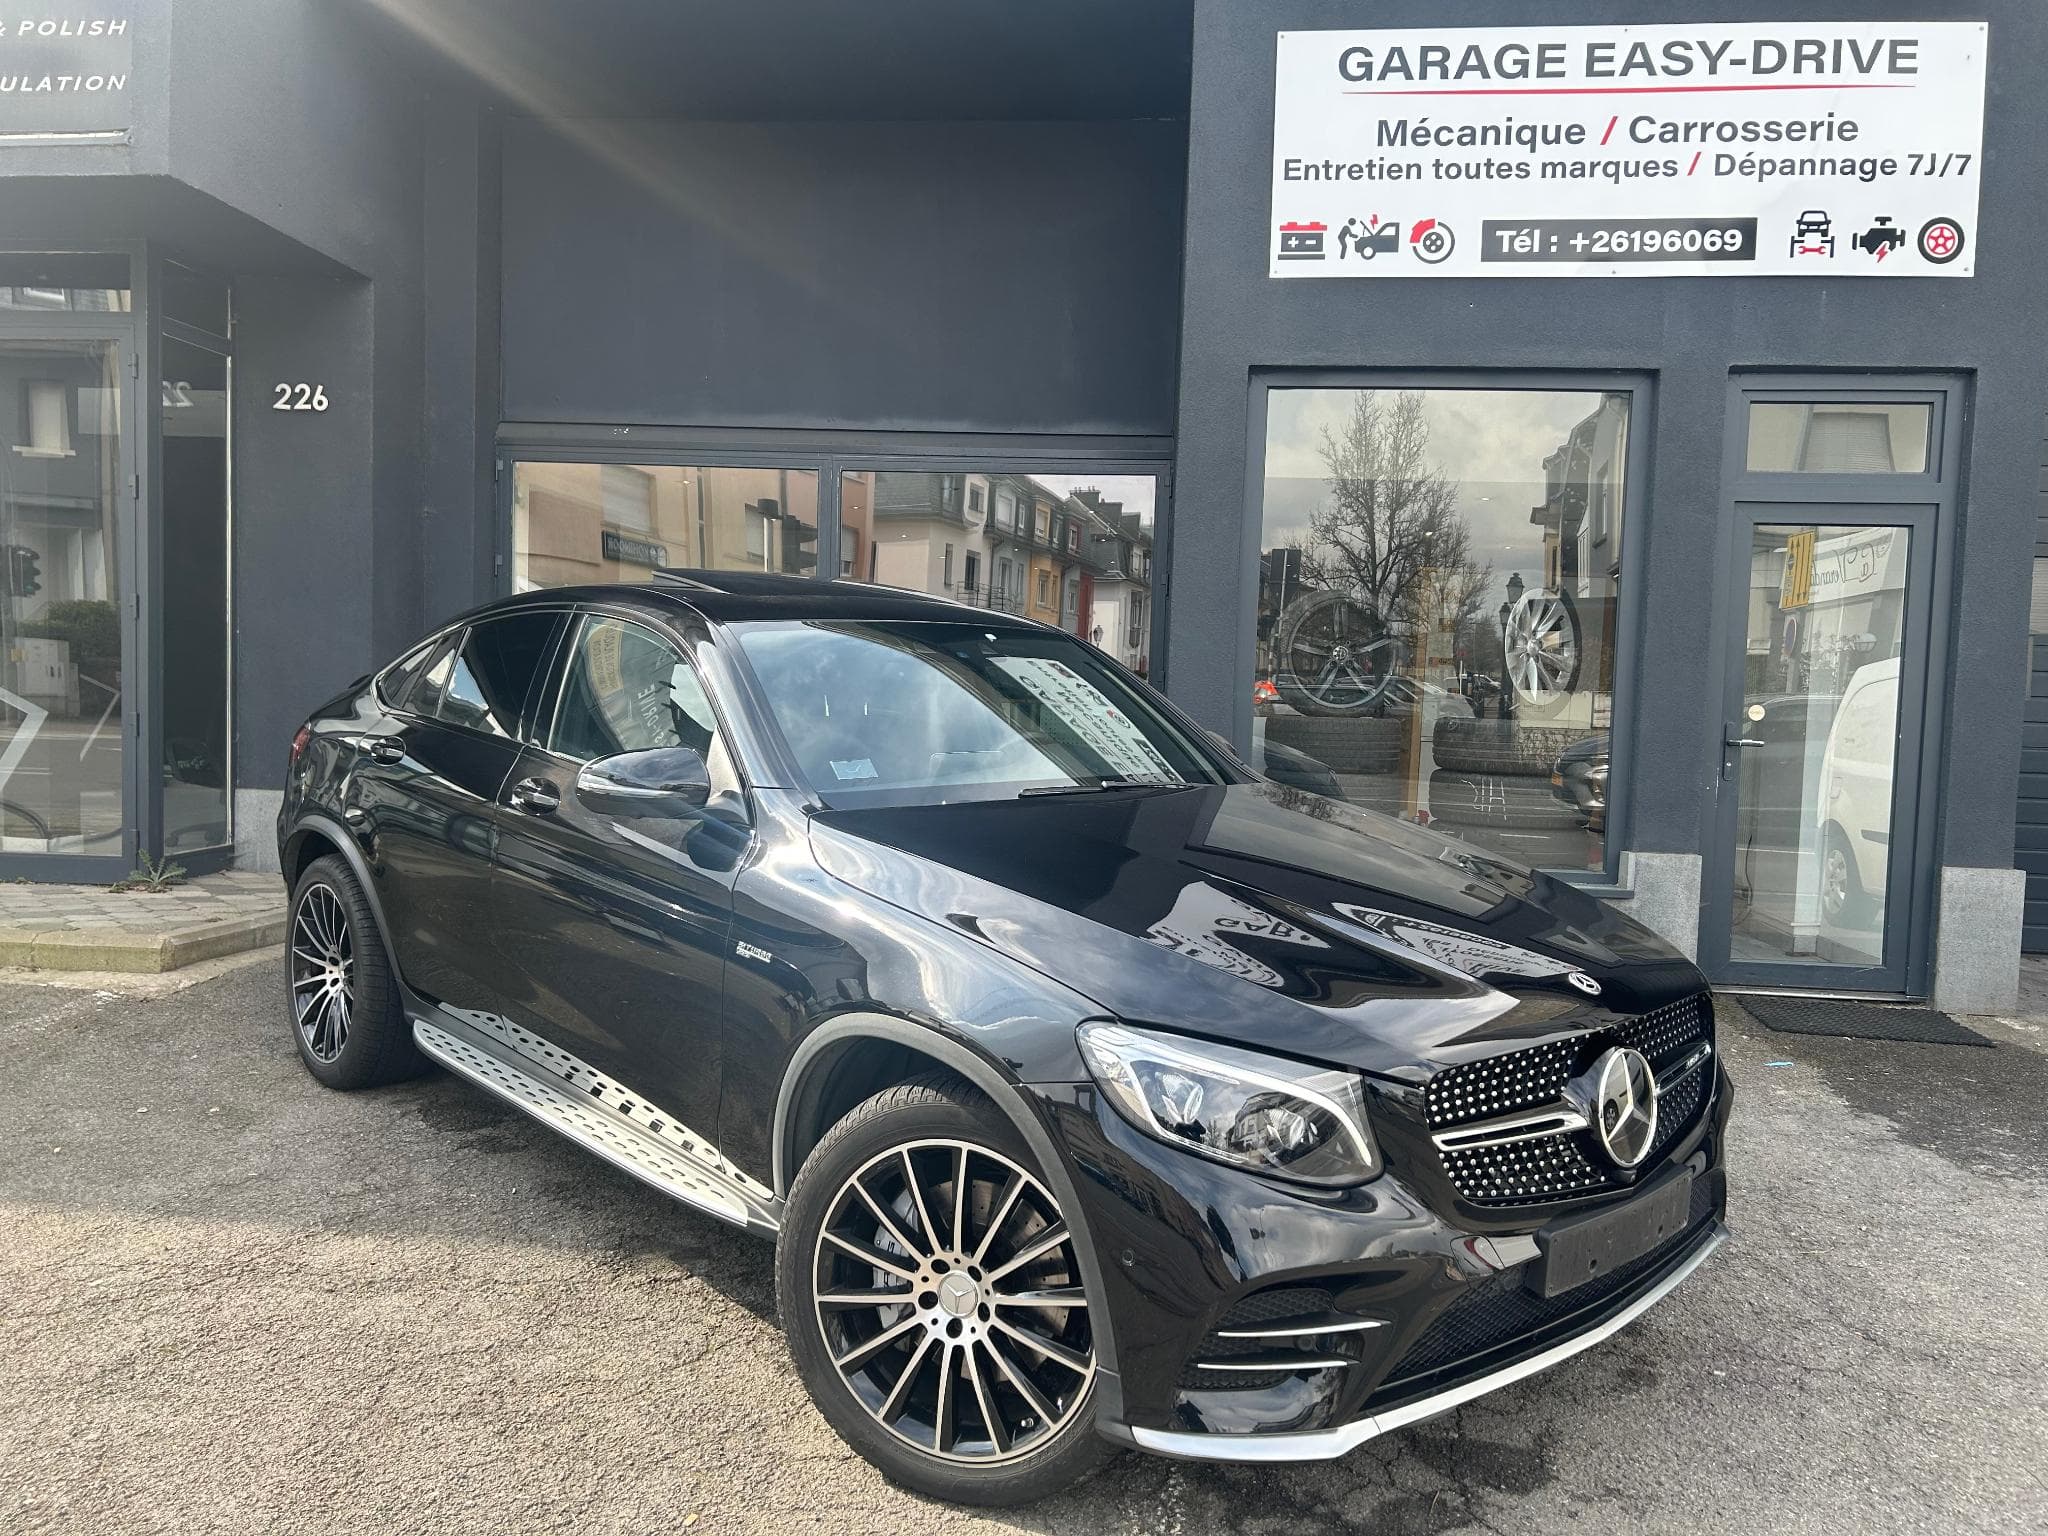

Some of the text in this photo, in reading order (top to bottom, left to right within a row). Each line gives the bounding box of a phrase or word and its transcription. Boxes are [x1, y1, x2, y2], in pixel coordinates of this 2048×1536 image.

[18, 19, 127, 36] POLISH
[1338, 39, 1919, 82] GARAGE EASY-DRIVE
[0, 74, 126, 92] ULATION
[1377, 116, 1586, 154] Mécanique
[1629, 111, 1859, 144] Carrosserie
[1284, 158, 1422, 181] Entretien
[1432, 158, 1531, 180] toutes
[1540, 159, 1678, 185] marques
[1714, 153, 1898, 183] Dépannage
[1907, 153, 1972, 178] 7J/7
[1495, 228, 1541, 253] Tél
[1569, 229, 1743, 253] +26196069
[272, 383, 329, 411] 226
